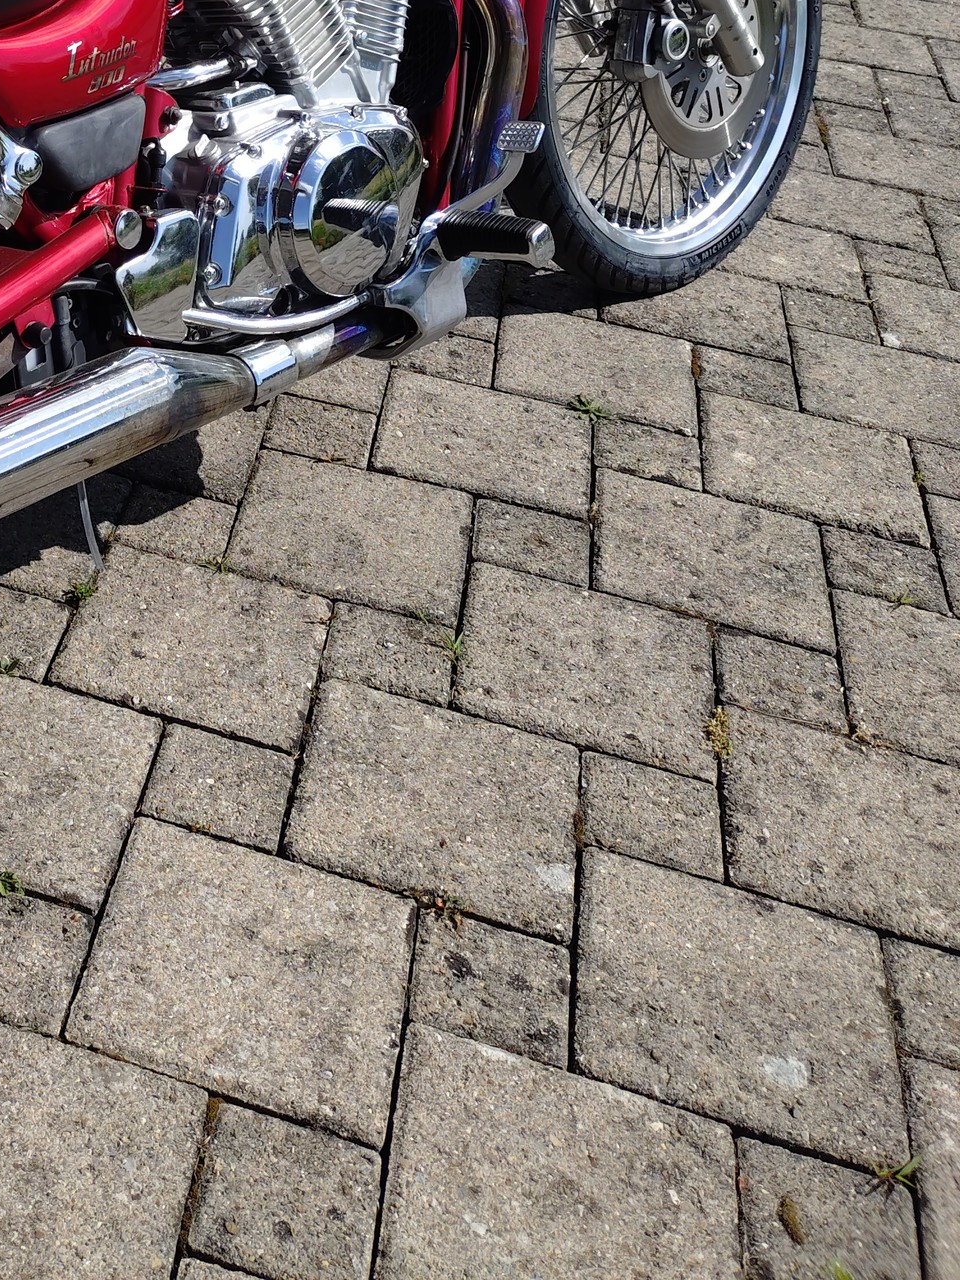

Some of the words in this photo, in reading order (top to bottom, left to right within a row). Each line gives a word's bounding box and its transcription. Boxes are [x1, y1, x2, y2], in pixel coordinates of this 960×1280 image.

[62, 35, 137, 82] Intruder
[87, 65, 126, 94] 800
[701, 228, 741, 261] MICHELIN
